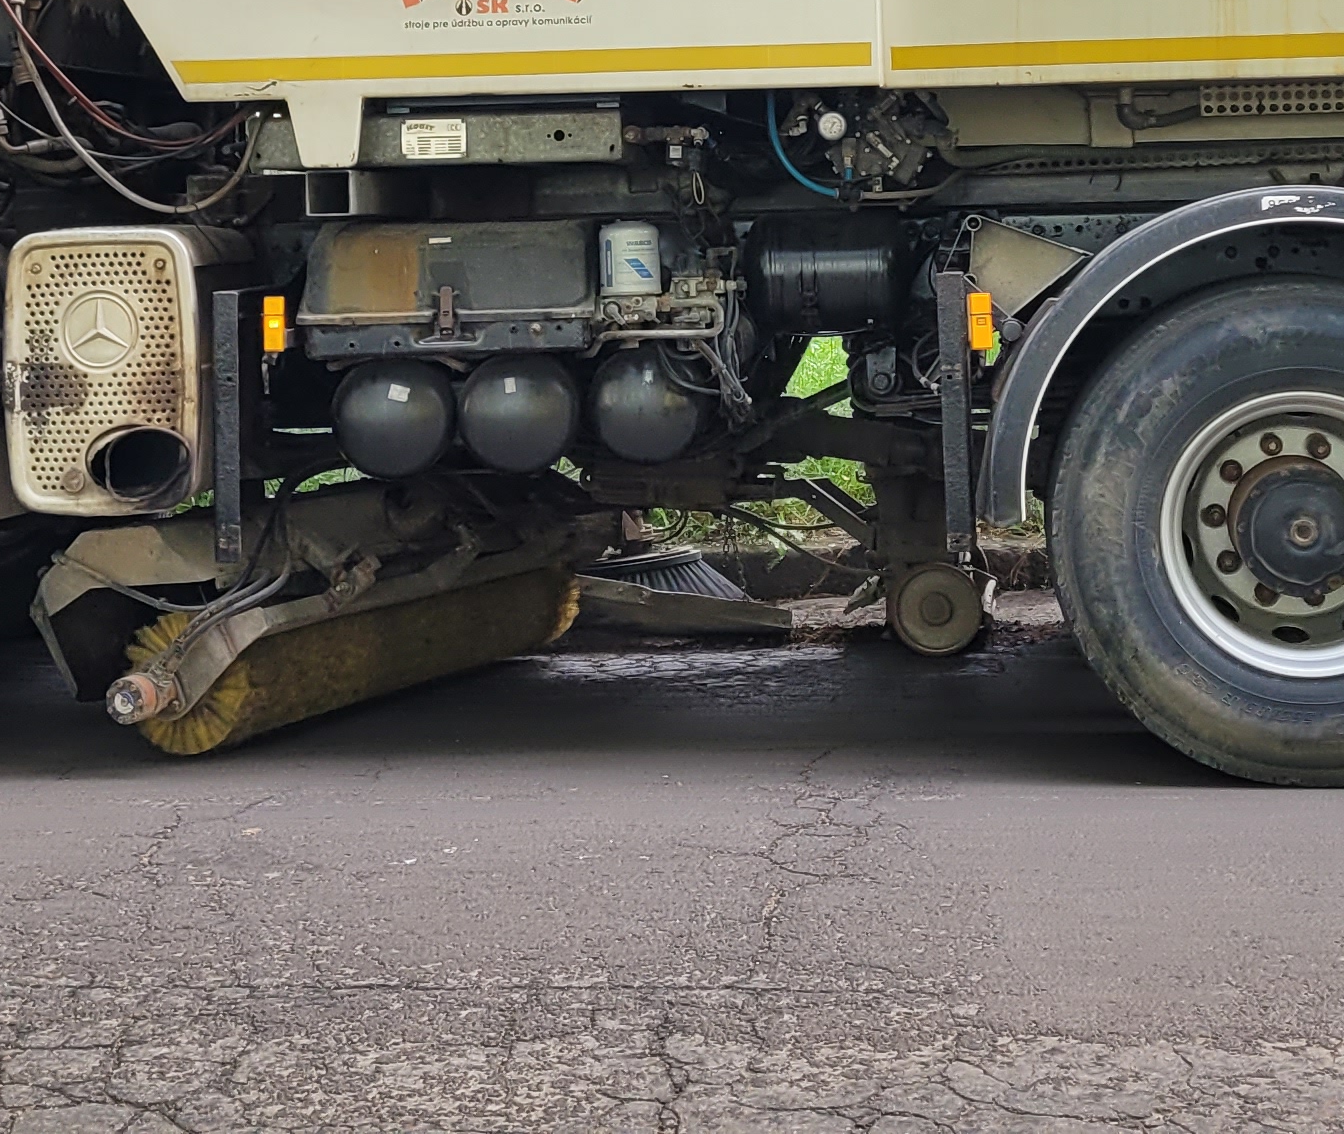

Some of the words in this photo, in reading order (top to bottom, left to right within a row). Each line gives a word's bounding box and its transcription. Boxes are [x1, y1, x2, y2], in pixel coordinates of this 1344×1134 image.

[515, 3, 545, 13] s.r.o.
[404, 20, 430, 30] stroje
[432, 21, 448, 29] pre
[495, 19, 530, 28] opravy
